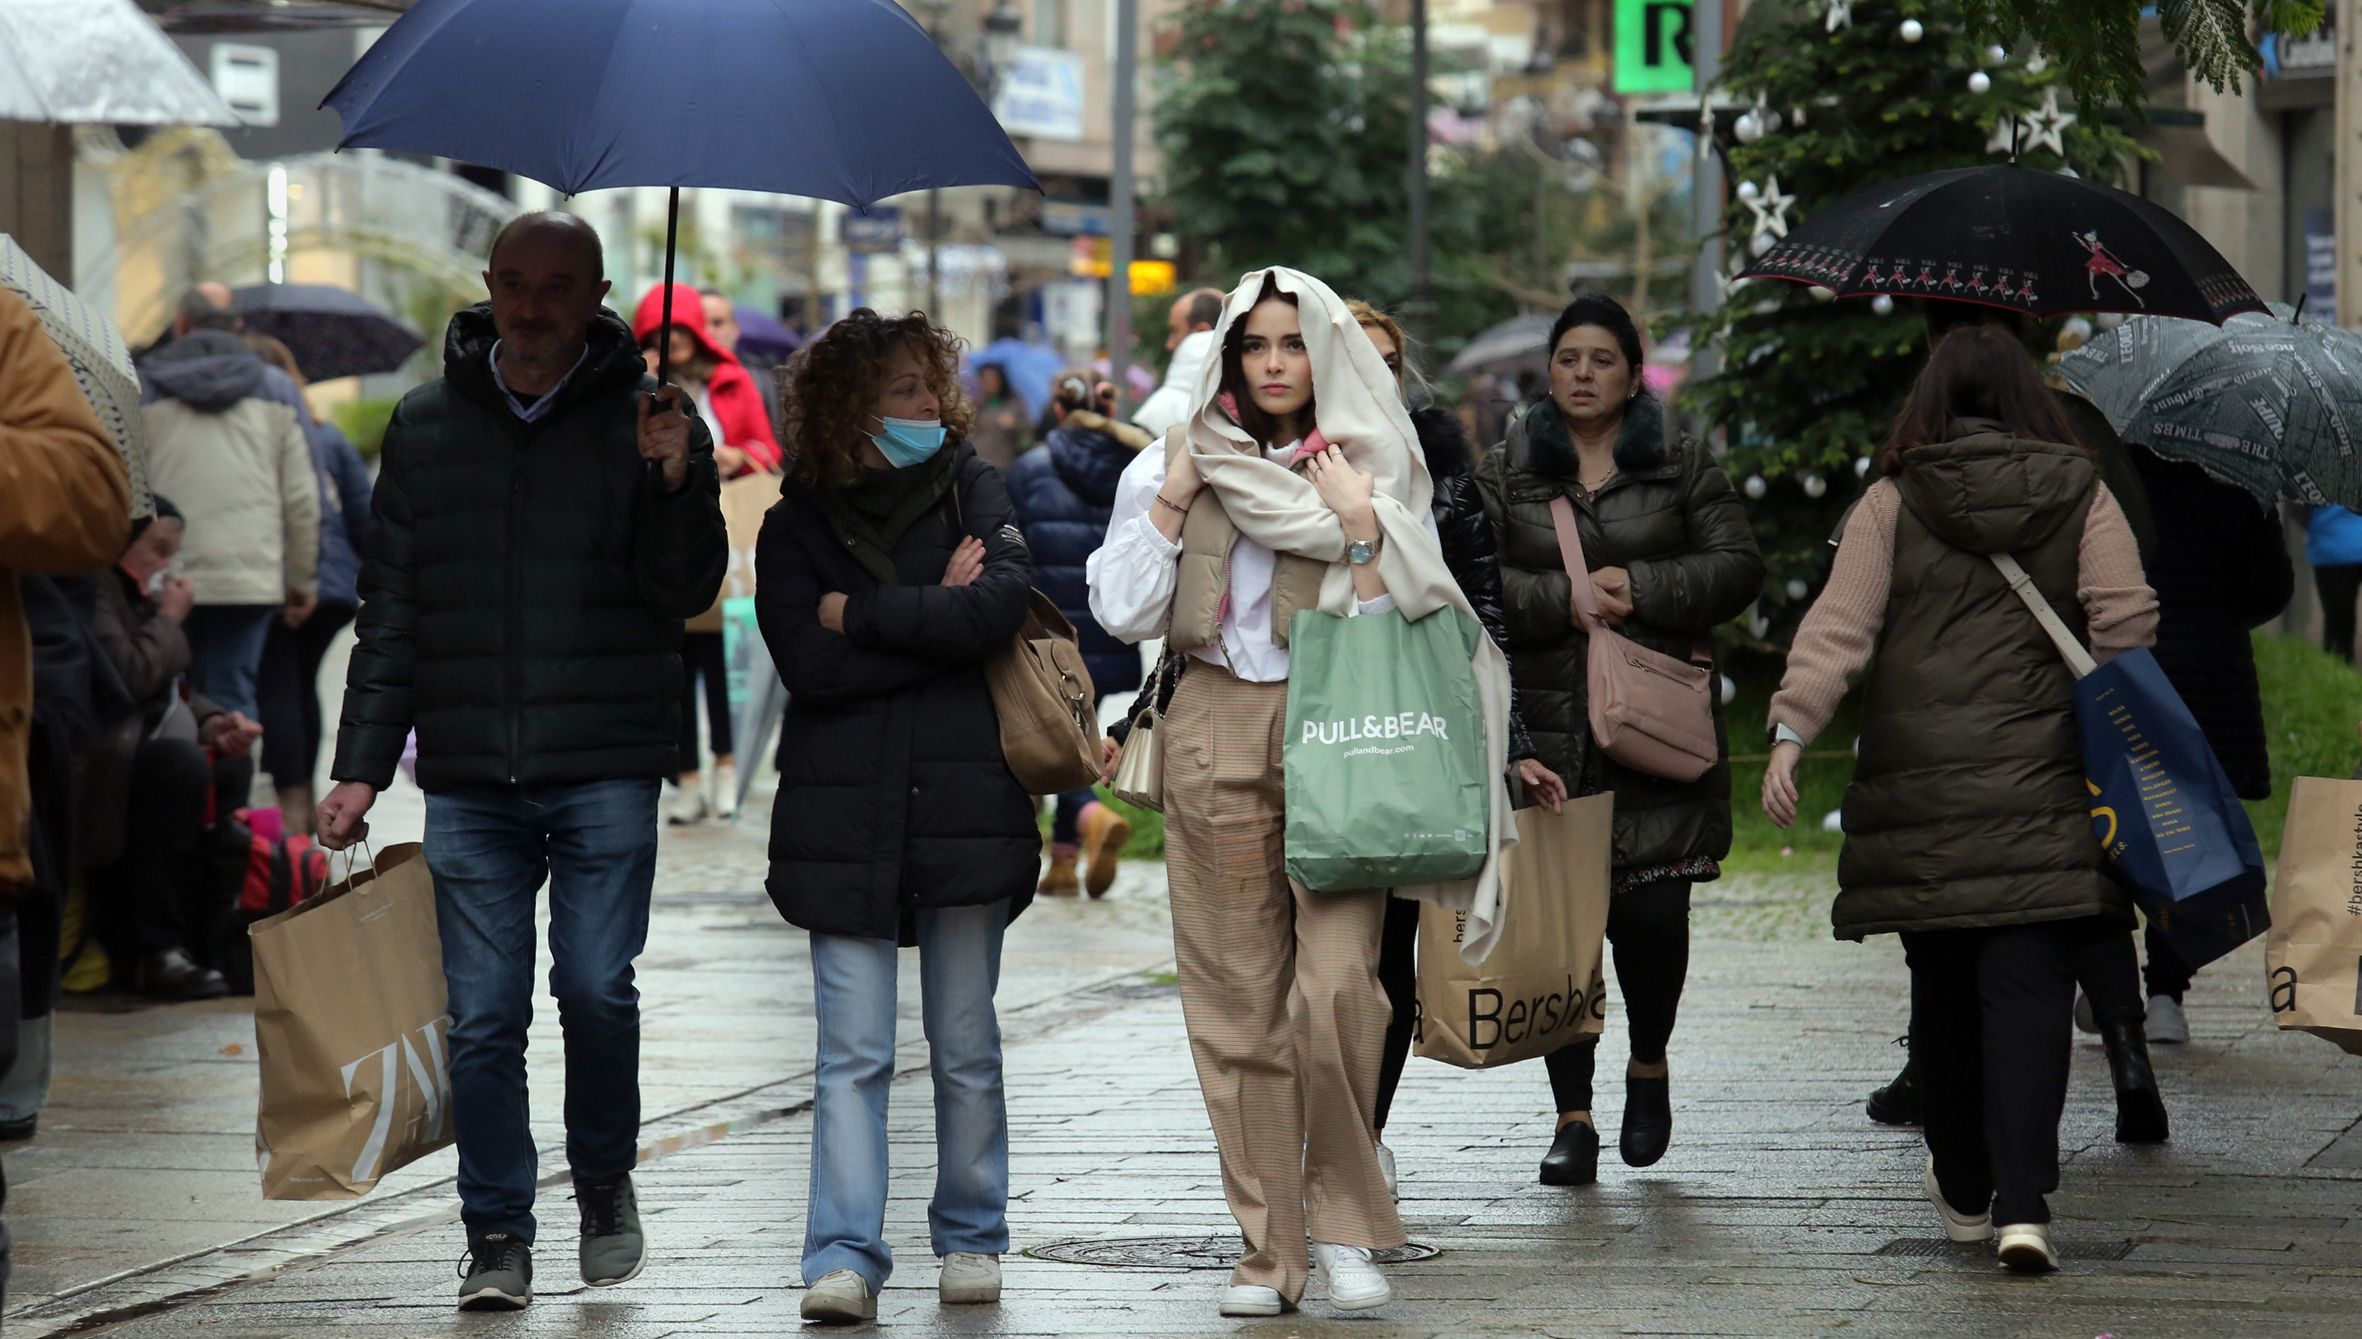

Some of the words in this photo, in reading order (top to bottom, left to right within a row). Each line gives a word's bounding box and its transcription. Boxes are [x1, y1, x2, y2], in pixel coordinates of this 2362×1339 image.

[1644, 4, 1694, 66] R
[2152, 422, 2201, 438] TIMES
[1302, 711, 1449, 745] PULL&BEAR
[1343, 743, 1415, 760] pullandbear.com
[2346, 803, 2362, 917] #bershkastl
